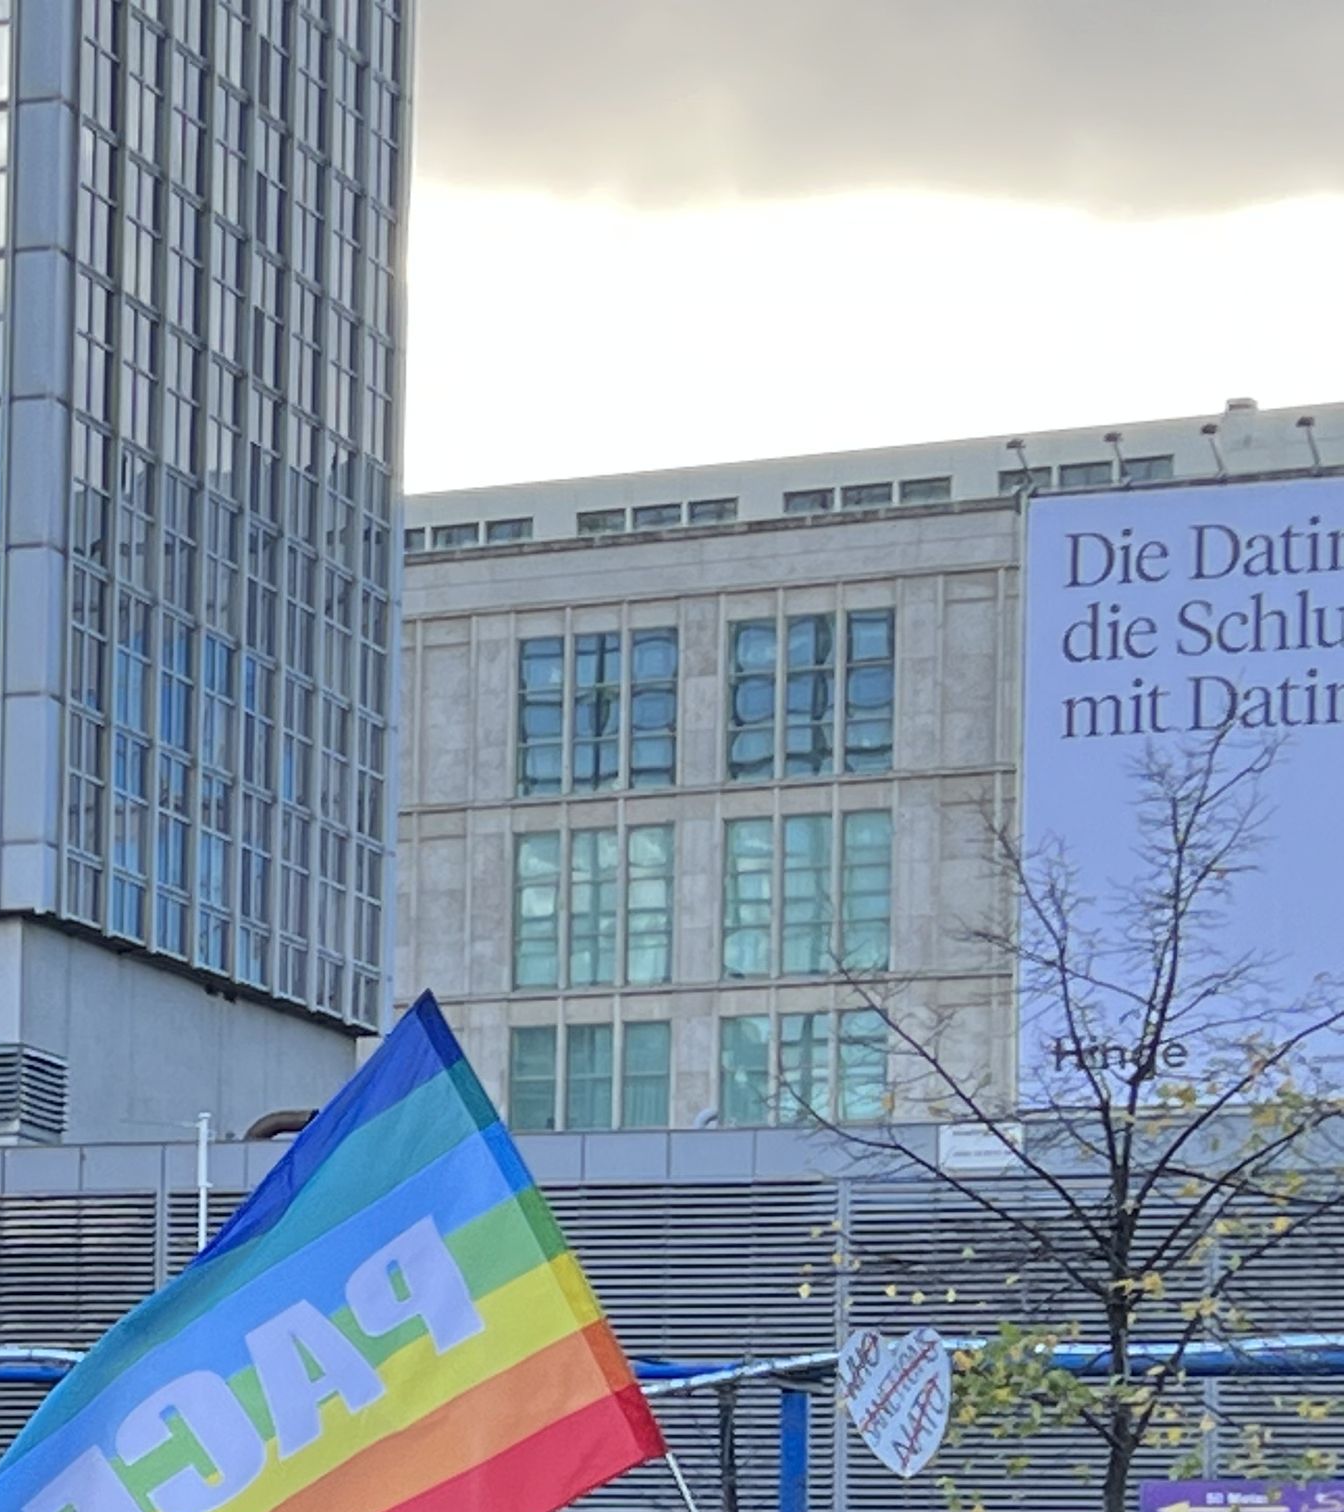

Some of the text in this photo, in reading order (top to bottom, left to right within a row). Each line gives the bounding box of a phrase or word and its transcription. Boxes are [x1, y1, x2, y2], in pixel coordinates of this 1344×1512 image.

[1063, 527, 1170, 588] Die
[1062, 588, 1344, 663] die Schlu
[1061, 677, 1174, 739] mit
[1053, 1036, 1189, 1080] Hine
[892, 1374, 944, 1469] NATO
